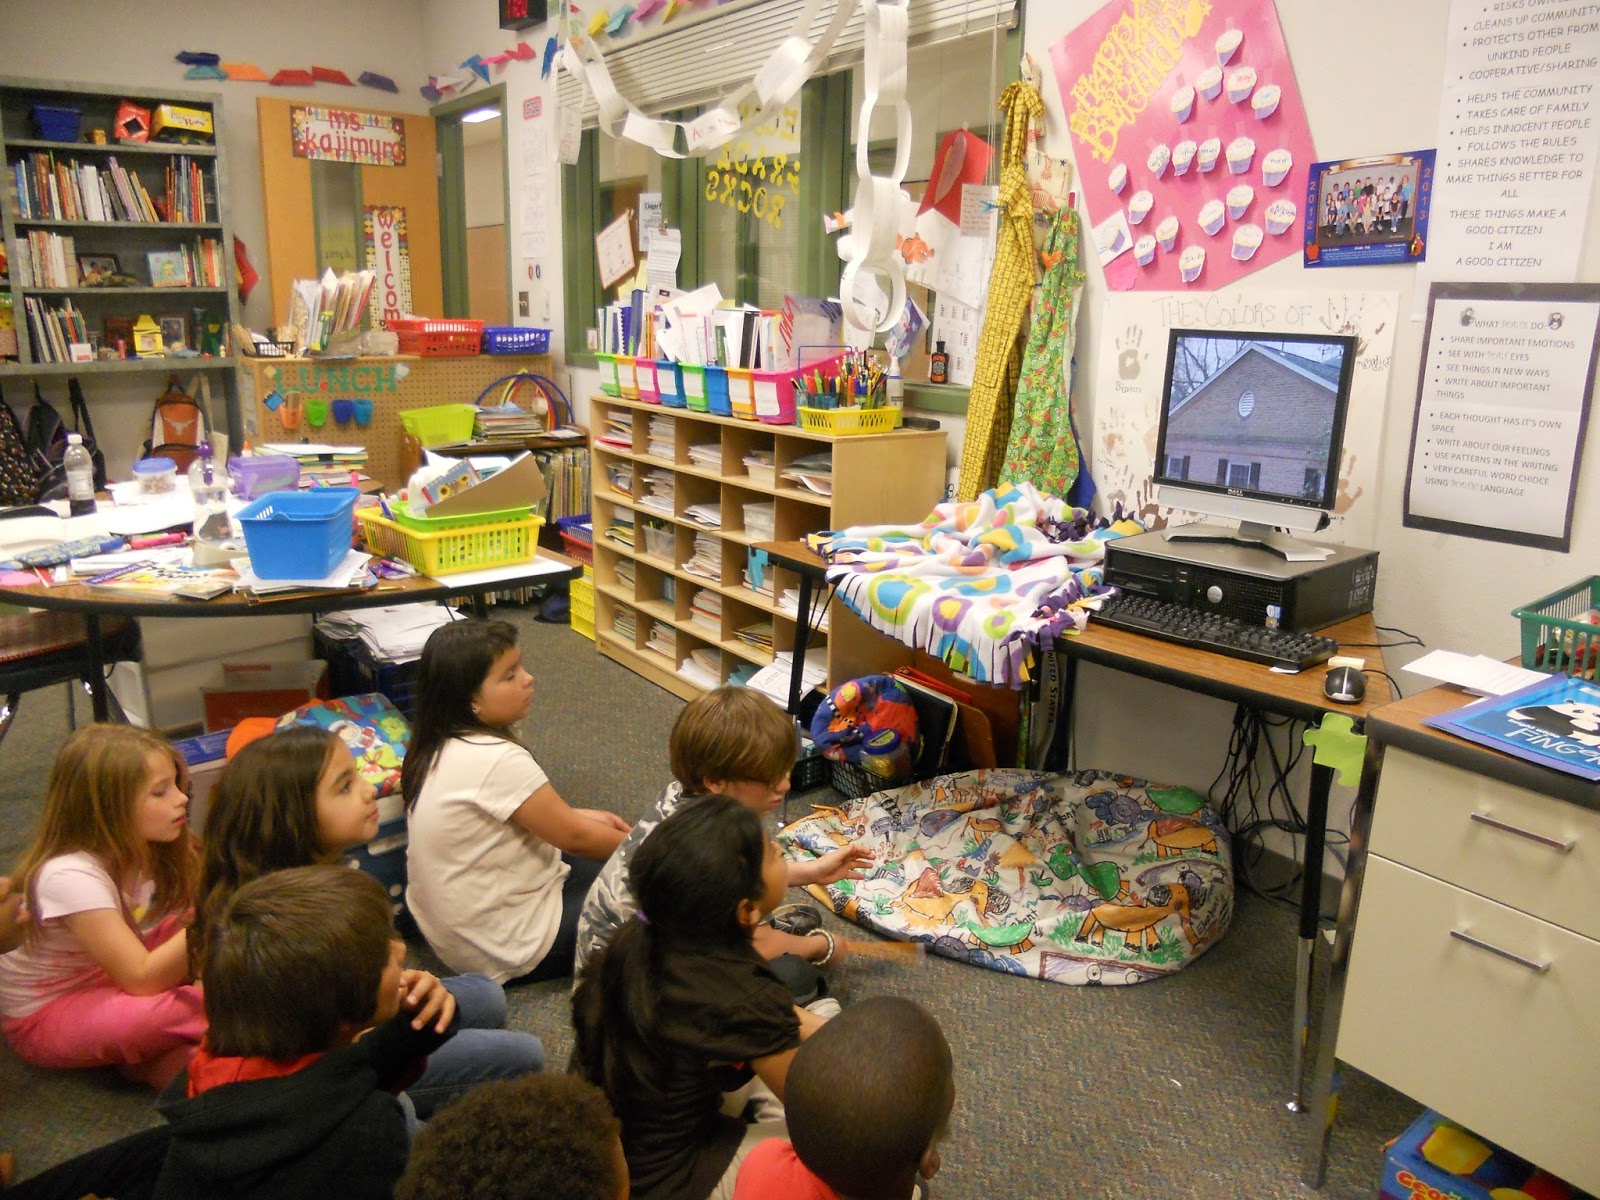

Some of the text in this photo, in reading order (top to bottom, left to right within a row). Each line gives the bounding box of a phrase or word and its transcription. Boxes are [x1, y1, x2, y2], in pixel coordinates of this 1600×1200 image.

[1493, 0, 1524, 12] RISKS
[1473, 6, 1600, 31] CLEANS UP COMMUNITY
[1472, 23, 1599, 47] PROTECTS OTHER FROM
[1488, 43, 1571, 62] UNKIND PEOPLE
[1469, 57, 1598, 80] COOPERATIVE/SHARING
[1467, 84, 1593, 104] HELPS THE COMMUNITY
[1467, 102, 1589, 119] TAKES CARE OF FAMILY
[1460, 118, 1591, 137] HELPS INNOCENT PEOPLE
[1467, 136, 1577, 152] FOLLOWS THE RULES
[1458, 153, 1584, 168] SHARES KNOWLEDGE TO
[1446, 170, 1583, 184] MAKE THINGS BETTER FOR
[1420, 168, 1431, 220] 2013
[1501, 189, 1519, 198] ALL
[1307, 181, 1316, 230] 2012
[1450, 209, 1566, 219] THESE THINGS MAKE A
[1466, 225, 1543, 235] GOOD CITIZEN
[1488, 242, 1512, 250] I AM
[378, 211, 400, 321] welcom
[1456, 257, 1542, 267] A GOOD CITIZEN
[1475, 320, 1499, 329] WHAT
[1450, 336, 1575, 348] SHARE IMPORTANT EMOTIONS
[1463, 350, 1485, 359] WITH
[1510, 353, 1529, 361] EYES
[1447, 364, 1550, 378] SEE THINGS IN NEW WAYS
[274, 366, 396, 394] LUNCH
[1445, 378, 1551, 392] WRITE ABOUT IMPORTANT
[1436, 390, 1465, 399] THINGS
[1431, 424, 1455, 433] SPACE
[1440, 412, 1460, 420] EACH
[1463, 413, 1501, 424] THOUGHT
[1503, 417, 1520, 426] HAS
[1539, 420, 1561, 429] OWN
[1436, 438, 1551, 457] WRITE ABOUT OUR FEELINGS
[1434, 451, 1558, 472] USE PATTERNS IN THE WRITING
[1433, 464, 1452, 473] VERY
[1454, 467, 1488, 478] CAREFUL
[1490, 471, 1516, 481] WORD
[1425, 477, 1448, 487] USING
[1480, 485, 1525, 496] LANGUAGE
